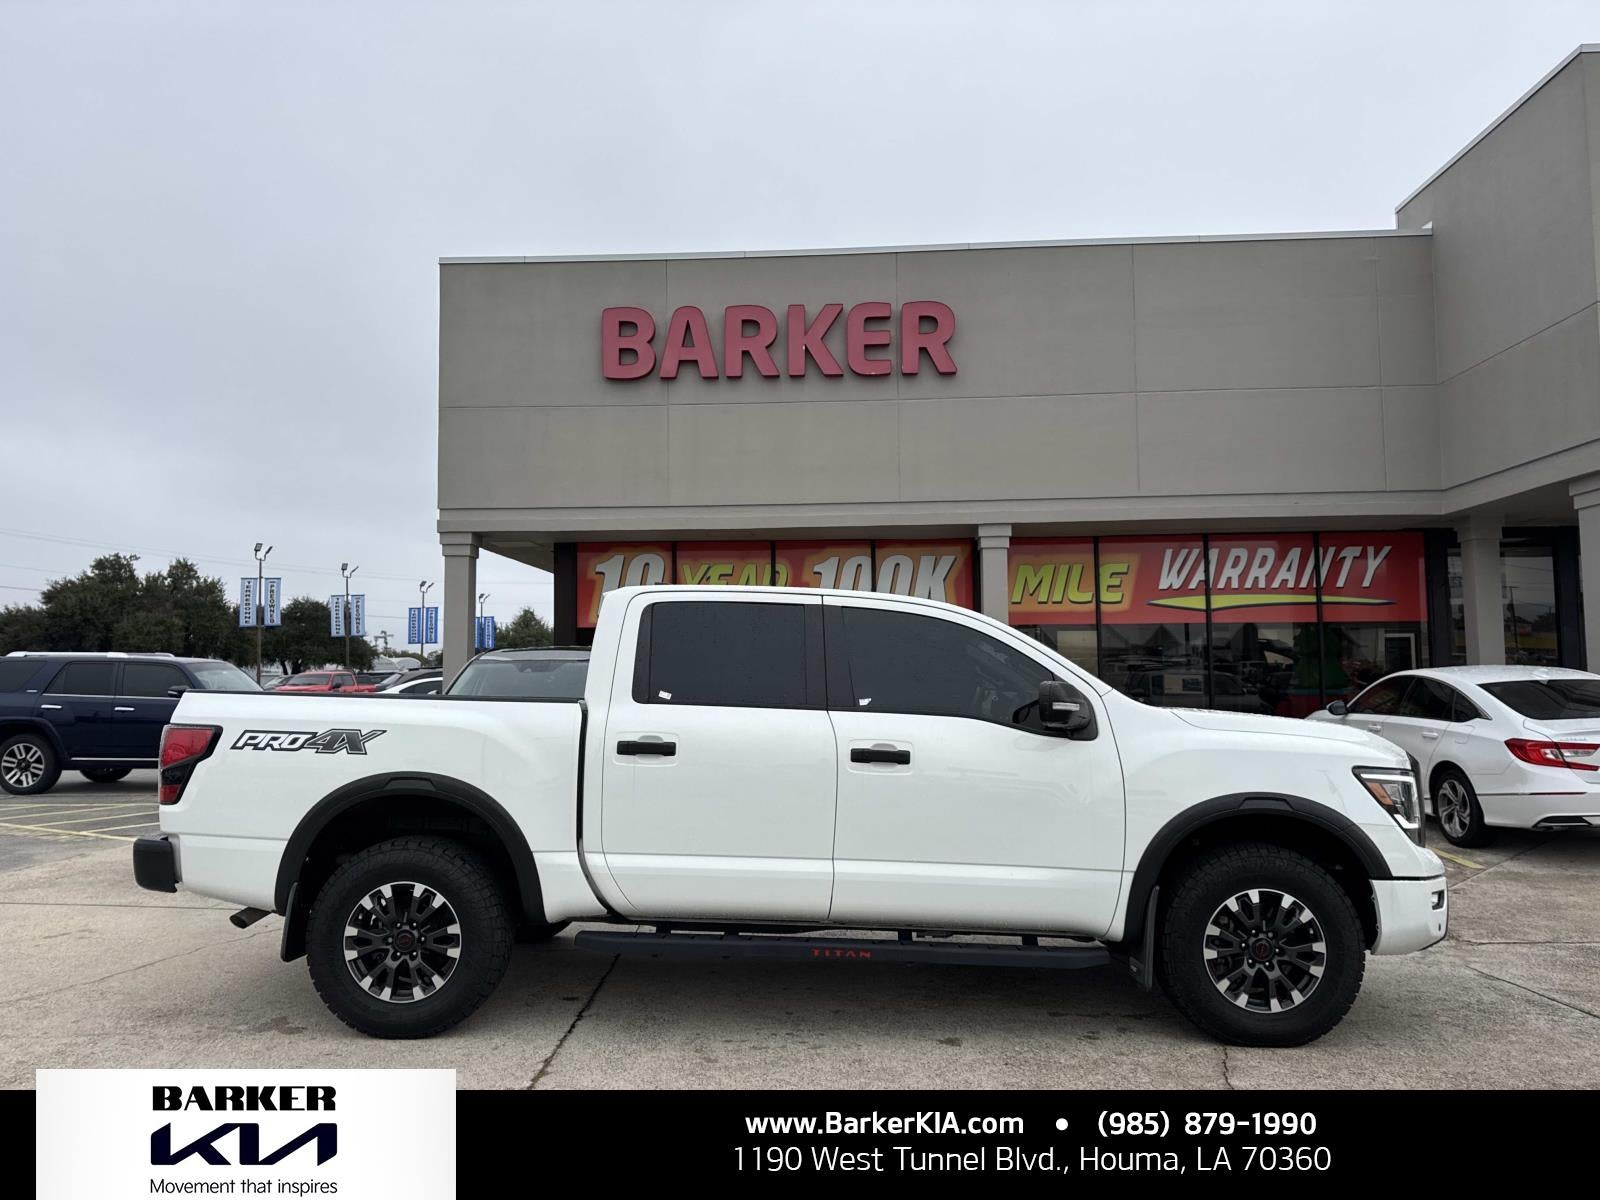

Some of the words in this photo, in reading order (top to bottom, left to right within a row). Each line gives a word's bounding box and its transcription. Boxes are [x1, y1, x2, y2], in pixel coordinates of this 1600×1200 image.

[602, 301, 957, 381] BARKER
[1011, 563, 1130, 605] MILE
[1158, 545, 1392, 590] WARRANTY
[230, 728, 387, 755] PRO4X
[812, 948, 872, 959] TITAN
